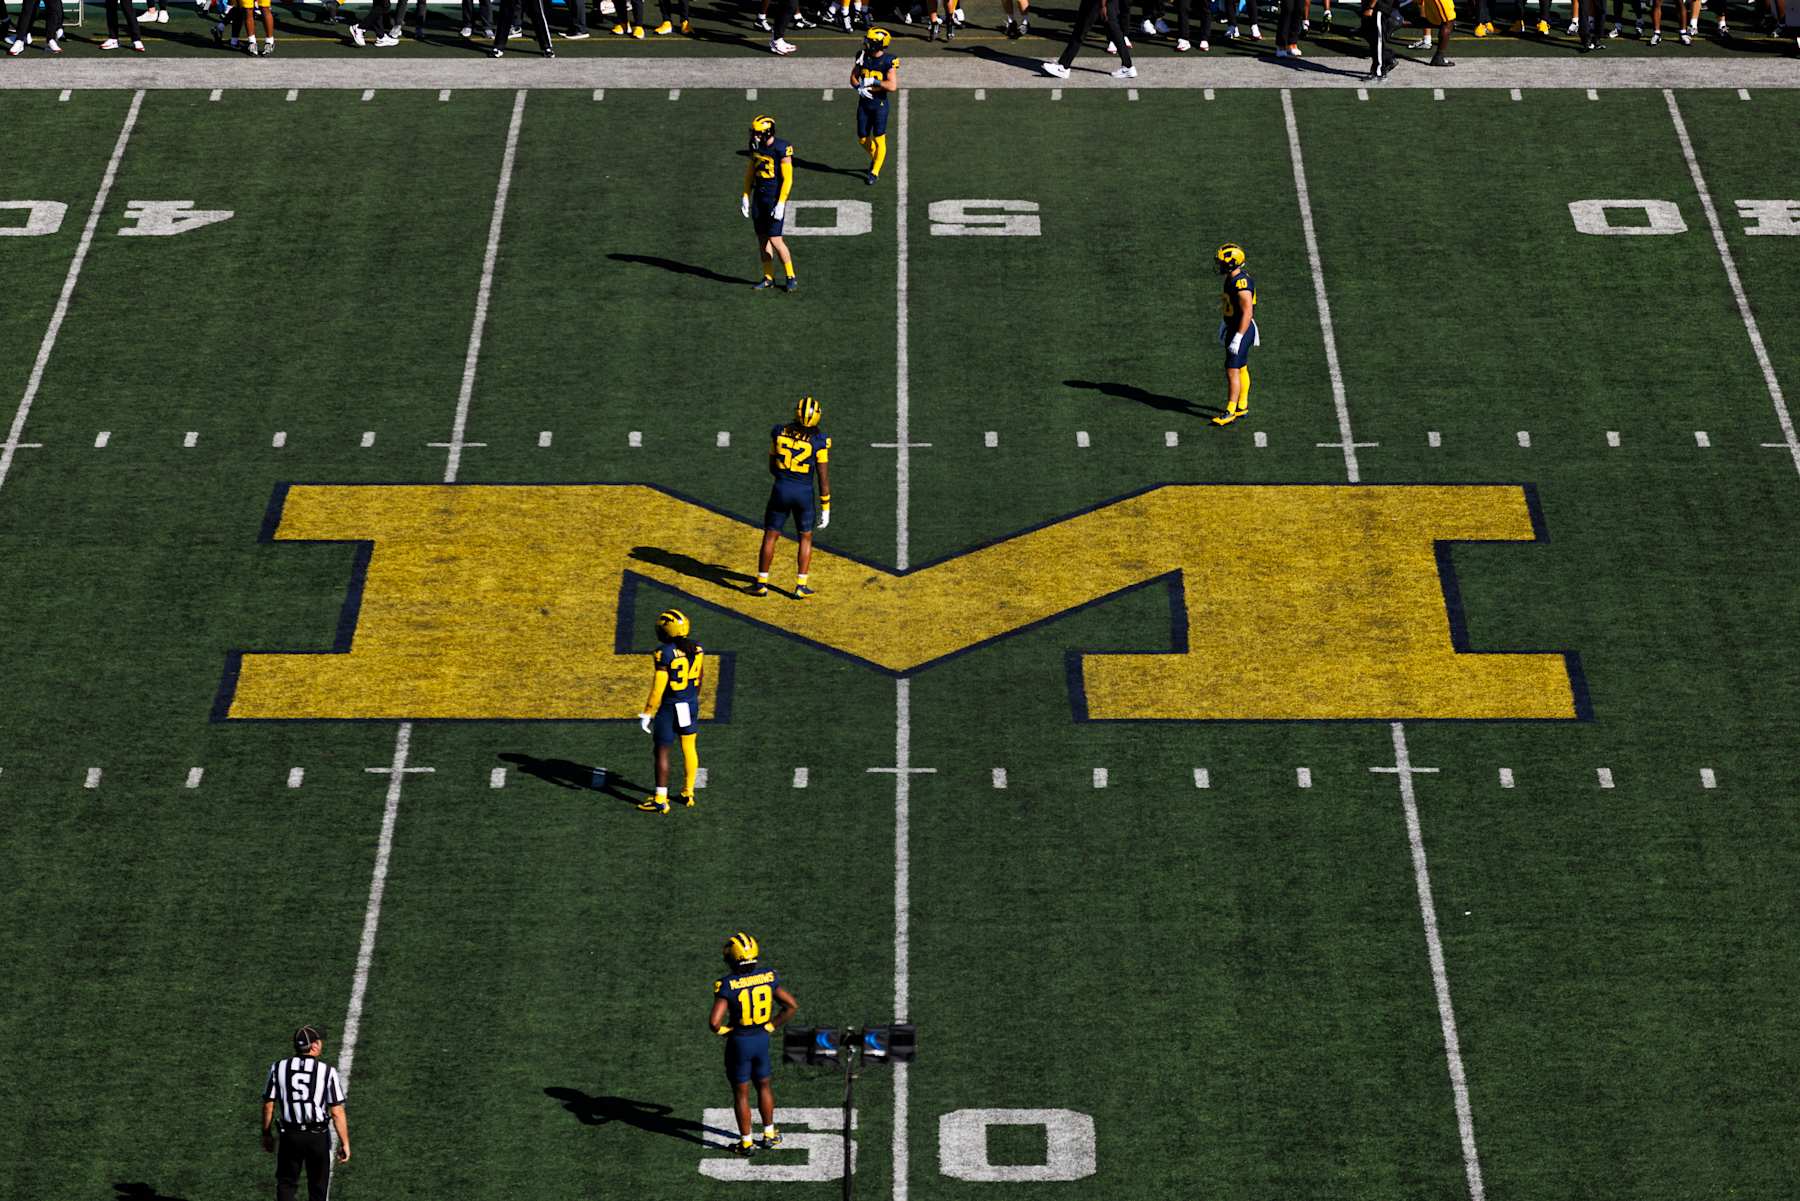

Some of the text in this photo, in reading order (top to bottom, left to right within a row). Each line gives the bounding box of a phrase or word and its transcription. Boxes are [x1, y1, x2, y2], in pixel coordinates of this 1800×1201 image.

[776, 435, 812, 474] 52
[212, 482, 1594, 723] M
[670, 655, 700, 691] 34
[738, 984, 773, 1026] 18
[291, 1072, 311, 1101] S
